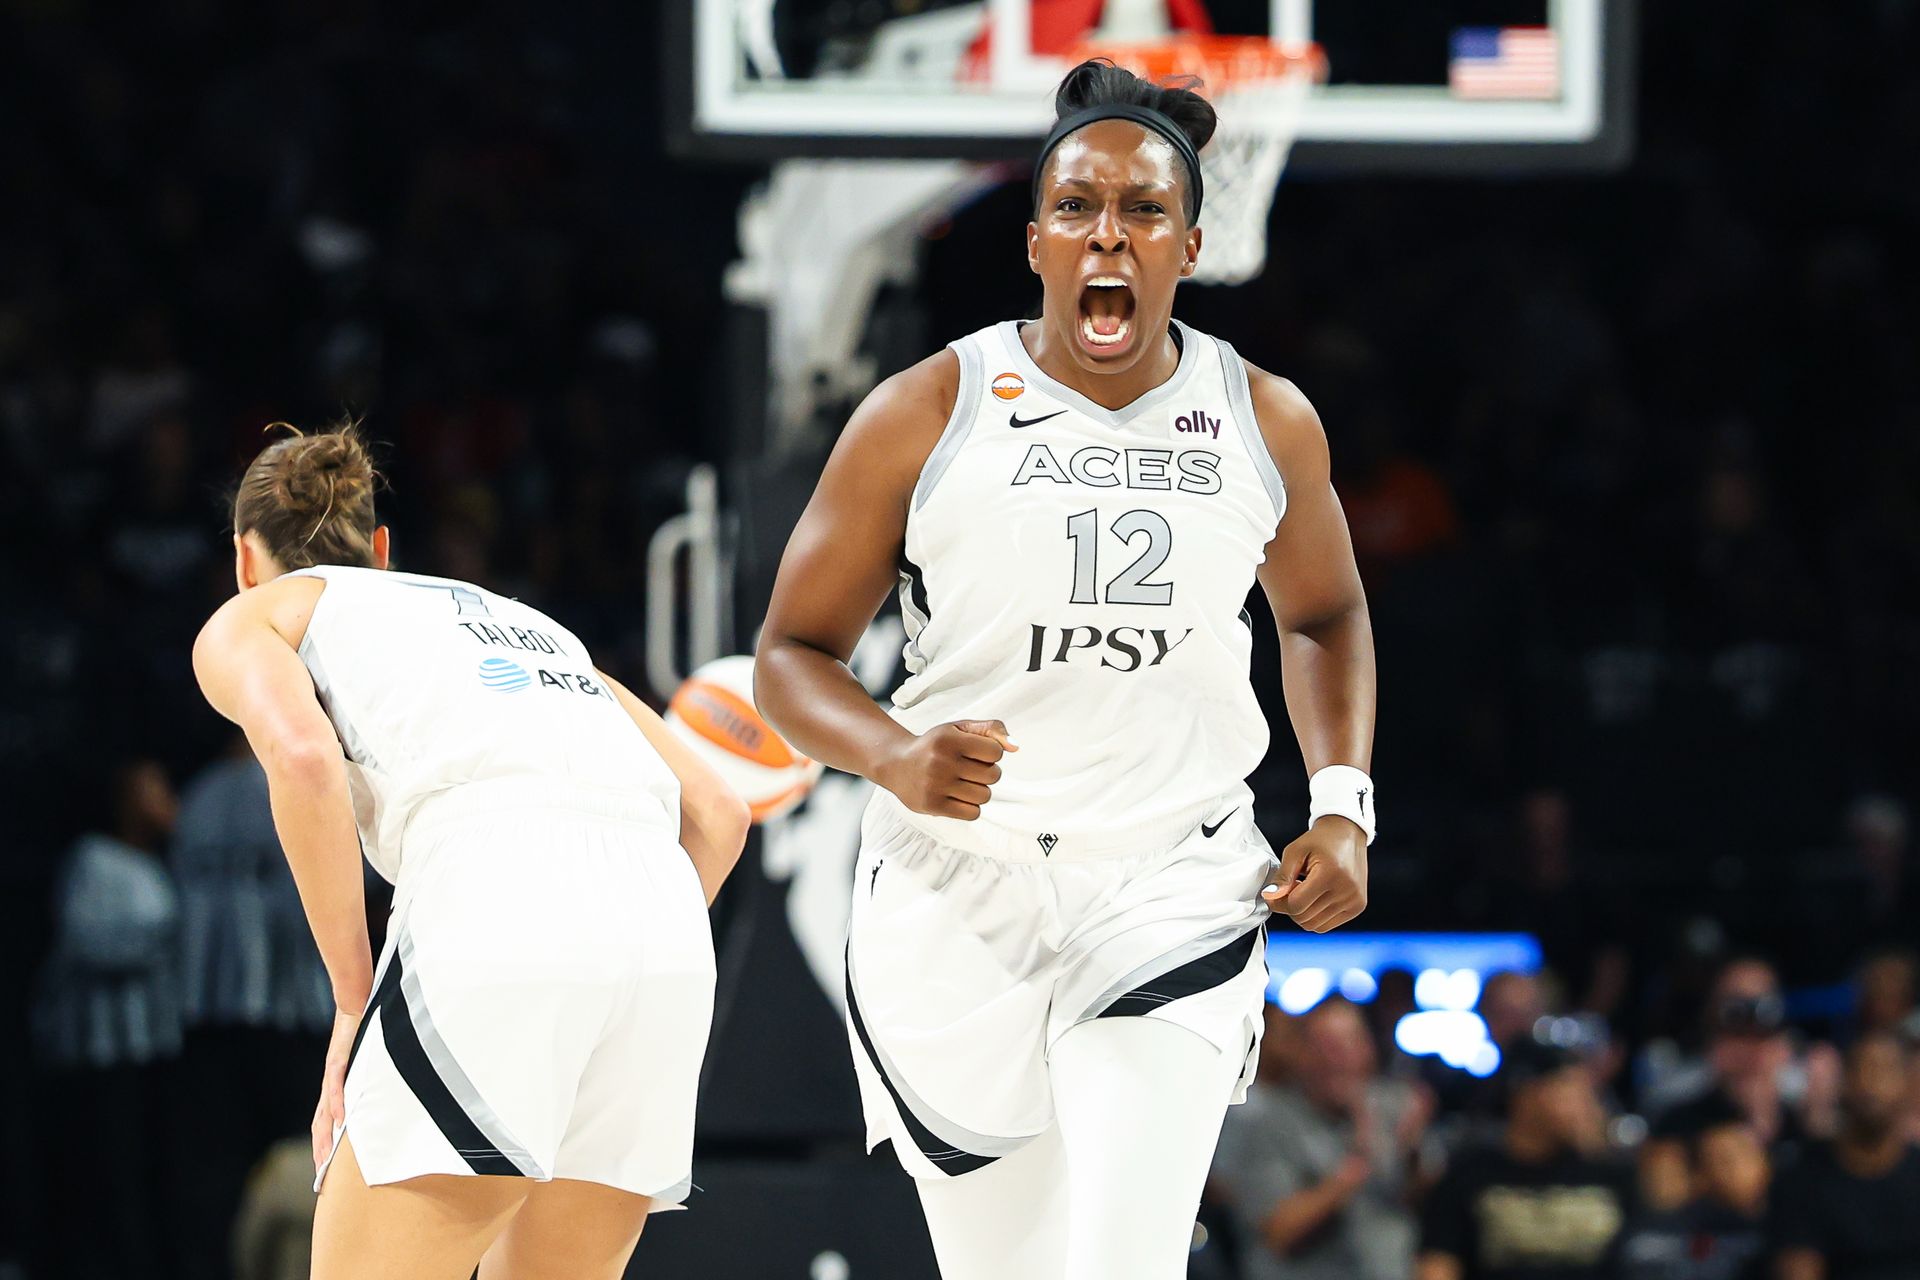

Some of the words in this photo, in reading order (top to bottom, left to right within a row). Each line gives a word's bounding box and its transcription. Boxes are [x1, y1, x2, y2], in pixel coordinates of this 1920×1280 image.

[1175, 410, 1221, 439] ally
[1011, 444, 1222, 495] ACES
[1067, 508, 1174, 605] 12
[1025, 623, 1194, 672] IPSY
